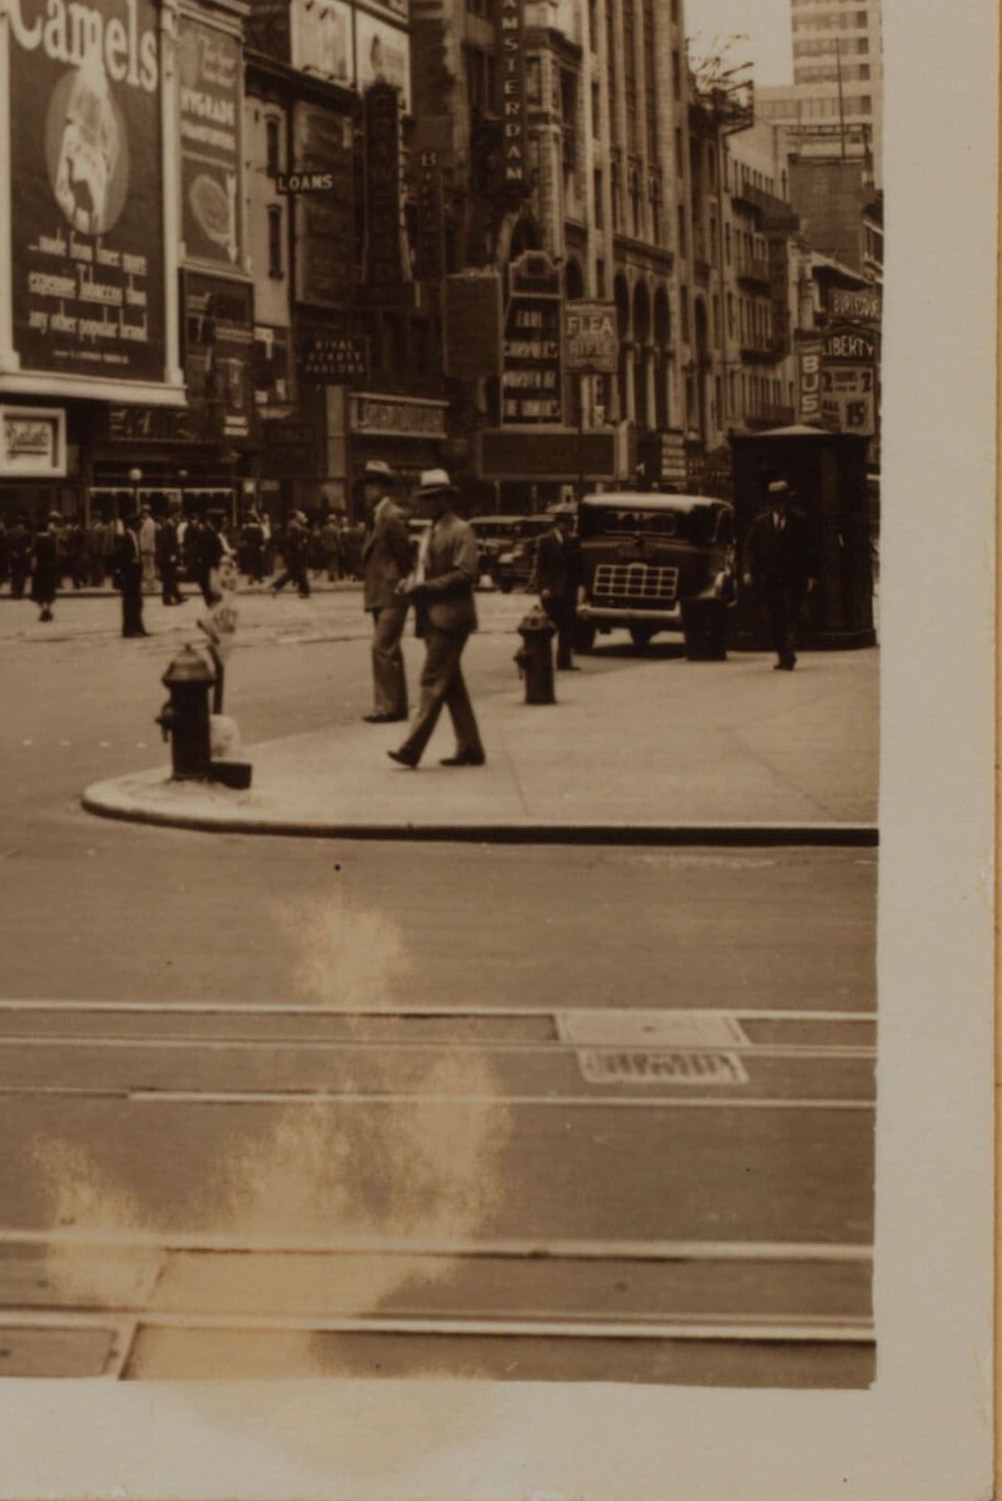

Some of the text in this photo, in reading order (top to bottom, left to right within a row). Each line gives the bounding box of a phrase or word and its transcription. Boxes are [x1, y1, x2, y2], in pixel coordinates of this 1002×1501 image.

[278, 174, 333, 190] LOANS
[566, 315, 614, 336] FLEA
[822, 334, 873, 357] LIBERTY
[801, 354, 820, 413] BUS
